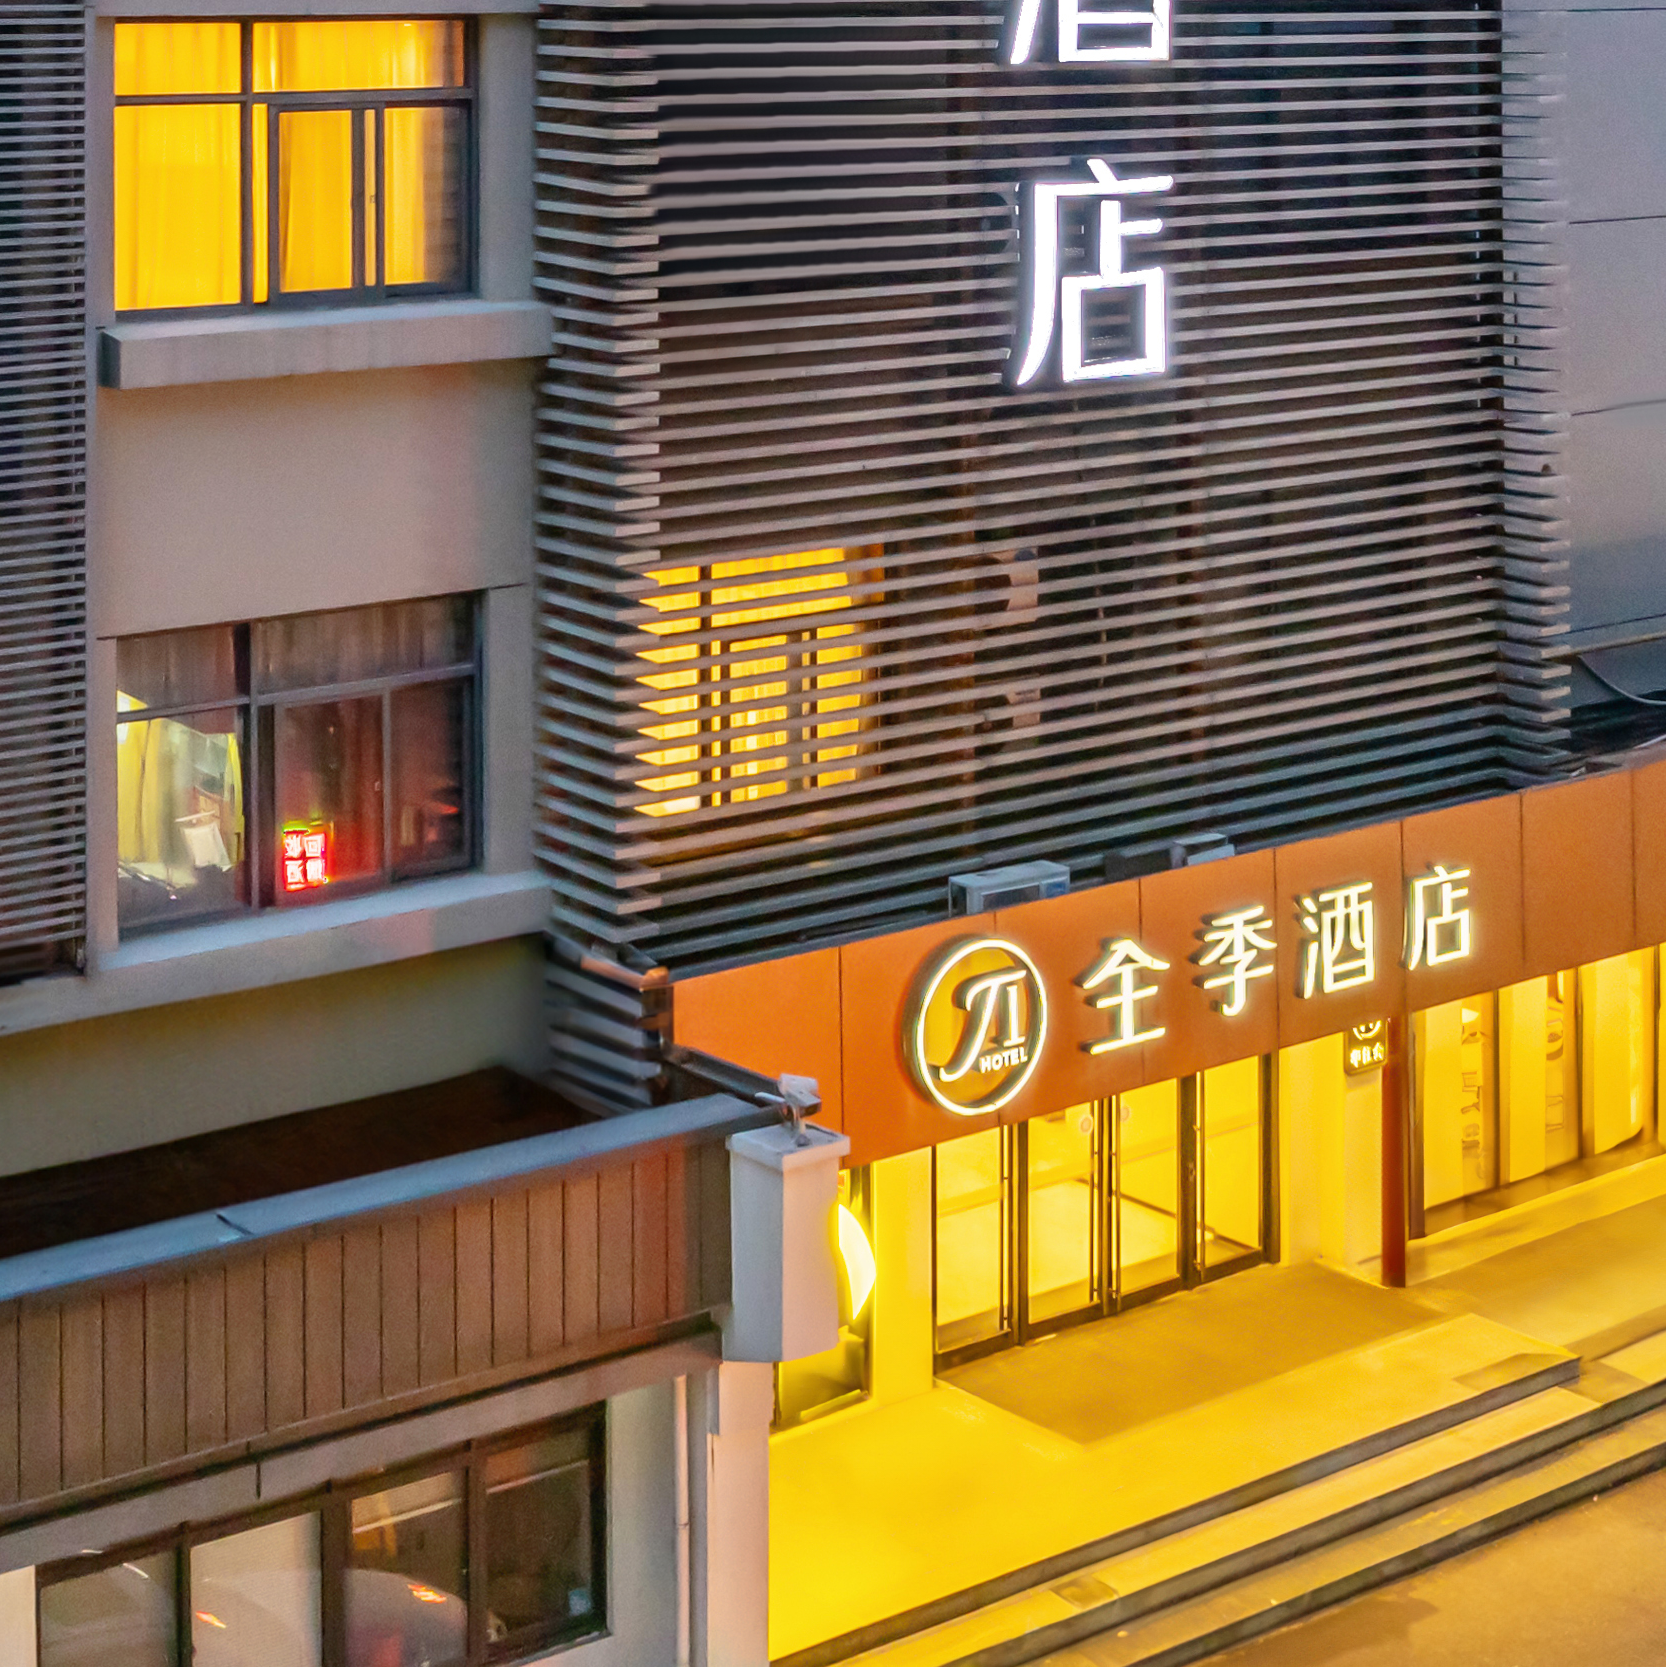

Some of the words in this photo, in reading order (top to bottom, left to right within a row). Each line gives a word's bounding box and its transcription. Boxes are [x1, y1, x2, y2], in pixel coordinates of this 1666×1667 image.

[1081, 864, 1473, 1056] 全季酒店
[979, 1045, 1029, 1074] HOTEL
